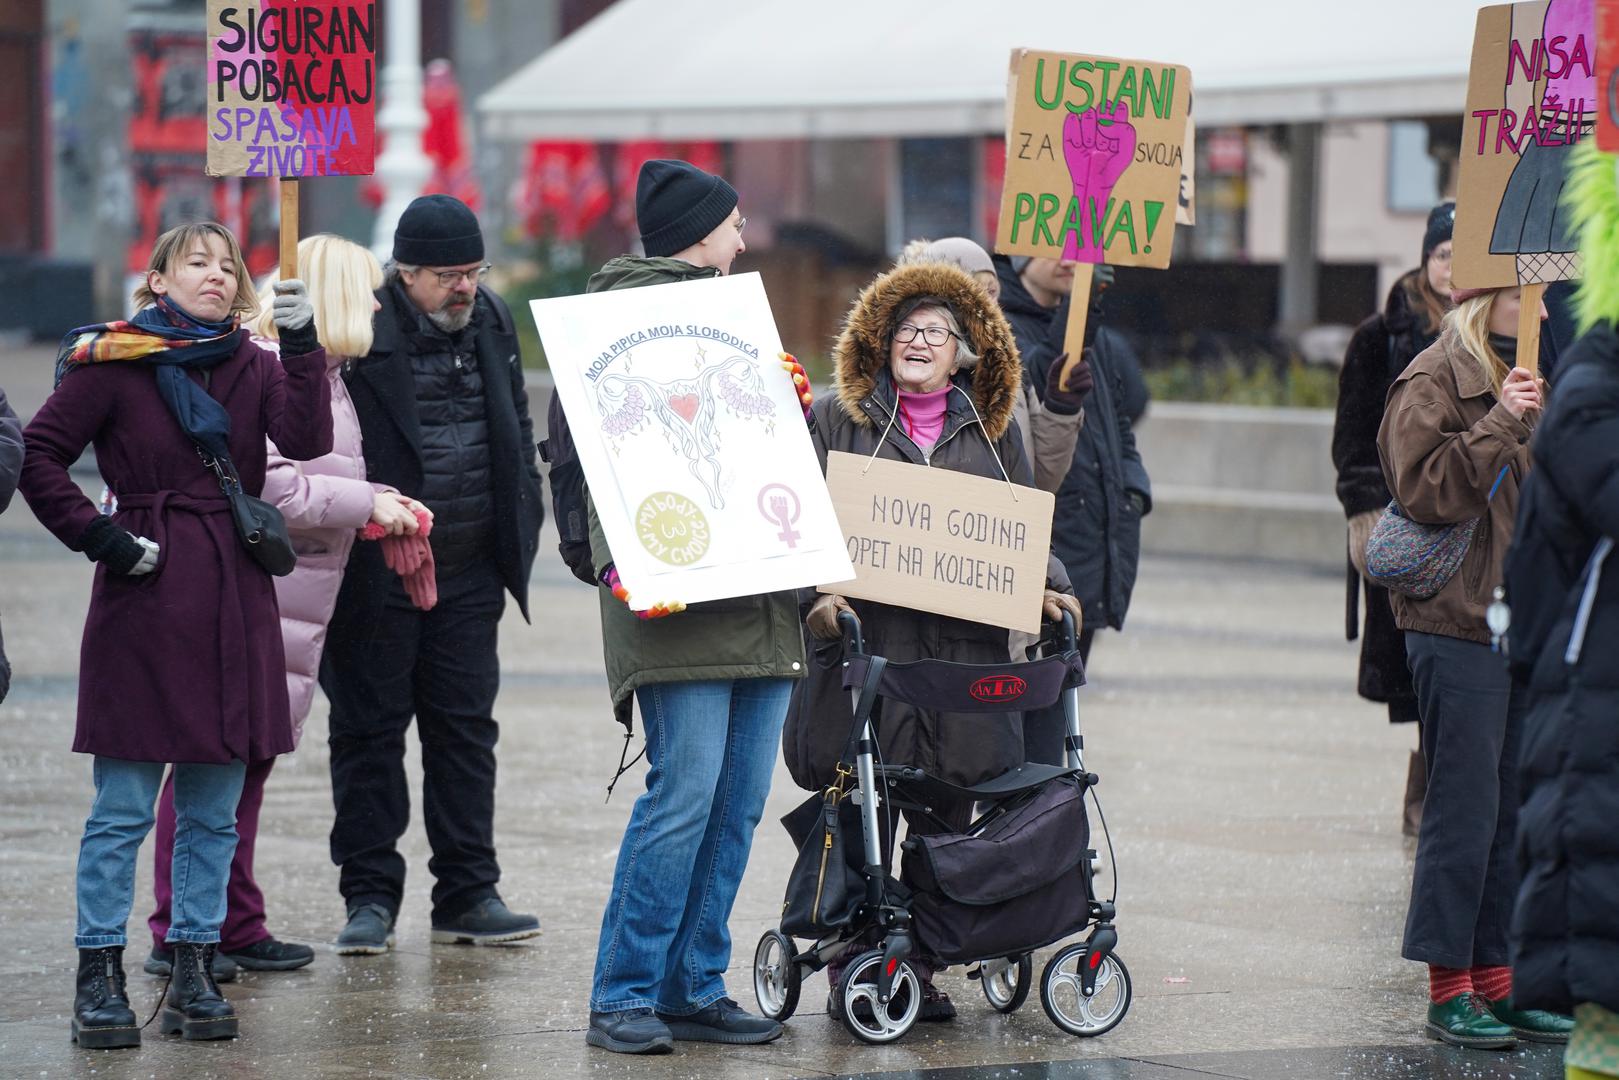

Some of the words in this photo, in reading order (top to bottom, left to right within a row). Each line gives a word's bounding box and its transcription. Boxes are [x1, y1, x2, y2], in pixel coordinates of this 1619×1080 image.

[217, 4, 374, 54] SIGURAN
[217, 51, 372, 104] POBAČAJ
[1506, 34, 1598, 85] NISA
[1035, 58, 1176, 119] USTANI
[213, 99, 357, 145] SPAŠAVA
[1018, 132, 1055, 161] ZA
[1135, 142, 1183, 168] SVOJA
[1010, 192, 1165, 254] PRAVA!
[585, 350, 613, 381] MOJA
[610, 331, 648, 355] PIPICA
[647, 324, 684, 339] MOJA
[686, 324, 760, 358] SLOBODICA
[872, 494, 931, 531] NOVA
[947, 509, 1026, 551] GODINA
[847, 535, 891, 569] OPET
[898, 544, 923, 576] NA
[934, 551, 1015, 595] KOLJENA
